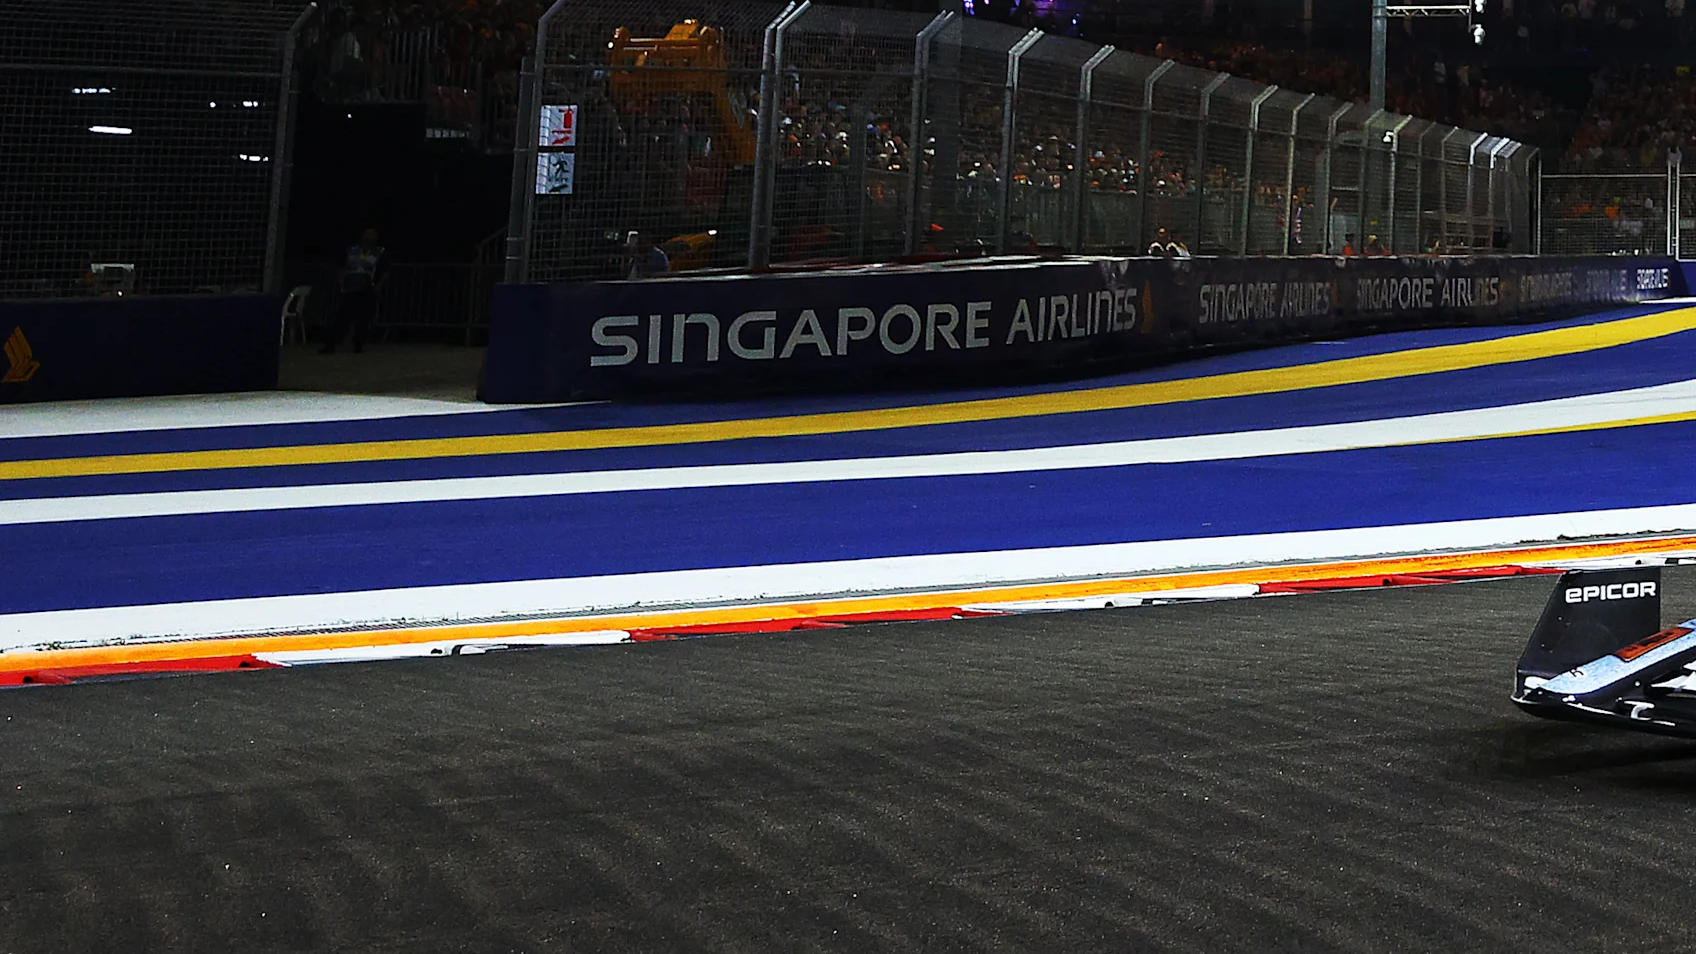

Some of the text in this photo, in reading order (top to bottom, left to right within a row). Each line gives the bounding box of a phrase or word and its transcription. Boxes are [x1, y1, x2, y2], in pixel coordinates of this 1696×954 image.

[1199, 280, 1331, 324] SINGAPORE AIRLINES
[1356, 277, 1434, 310] SINGAPORE
[1440, 277, 1499, 308] AIRLINES
[589, 287, 1137, 367] SINGAPORE AIRLINES
[1565, 581, 1657, 604] EPICOR
